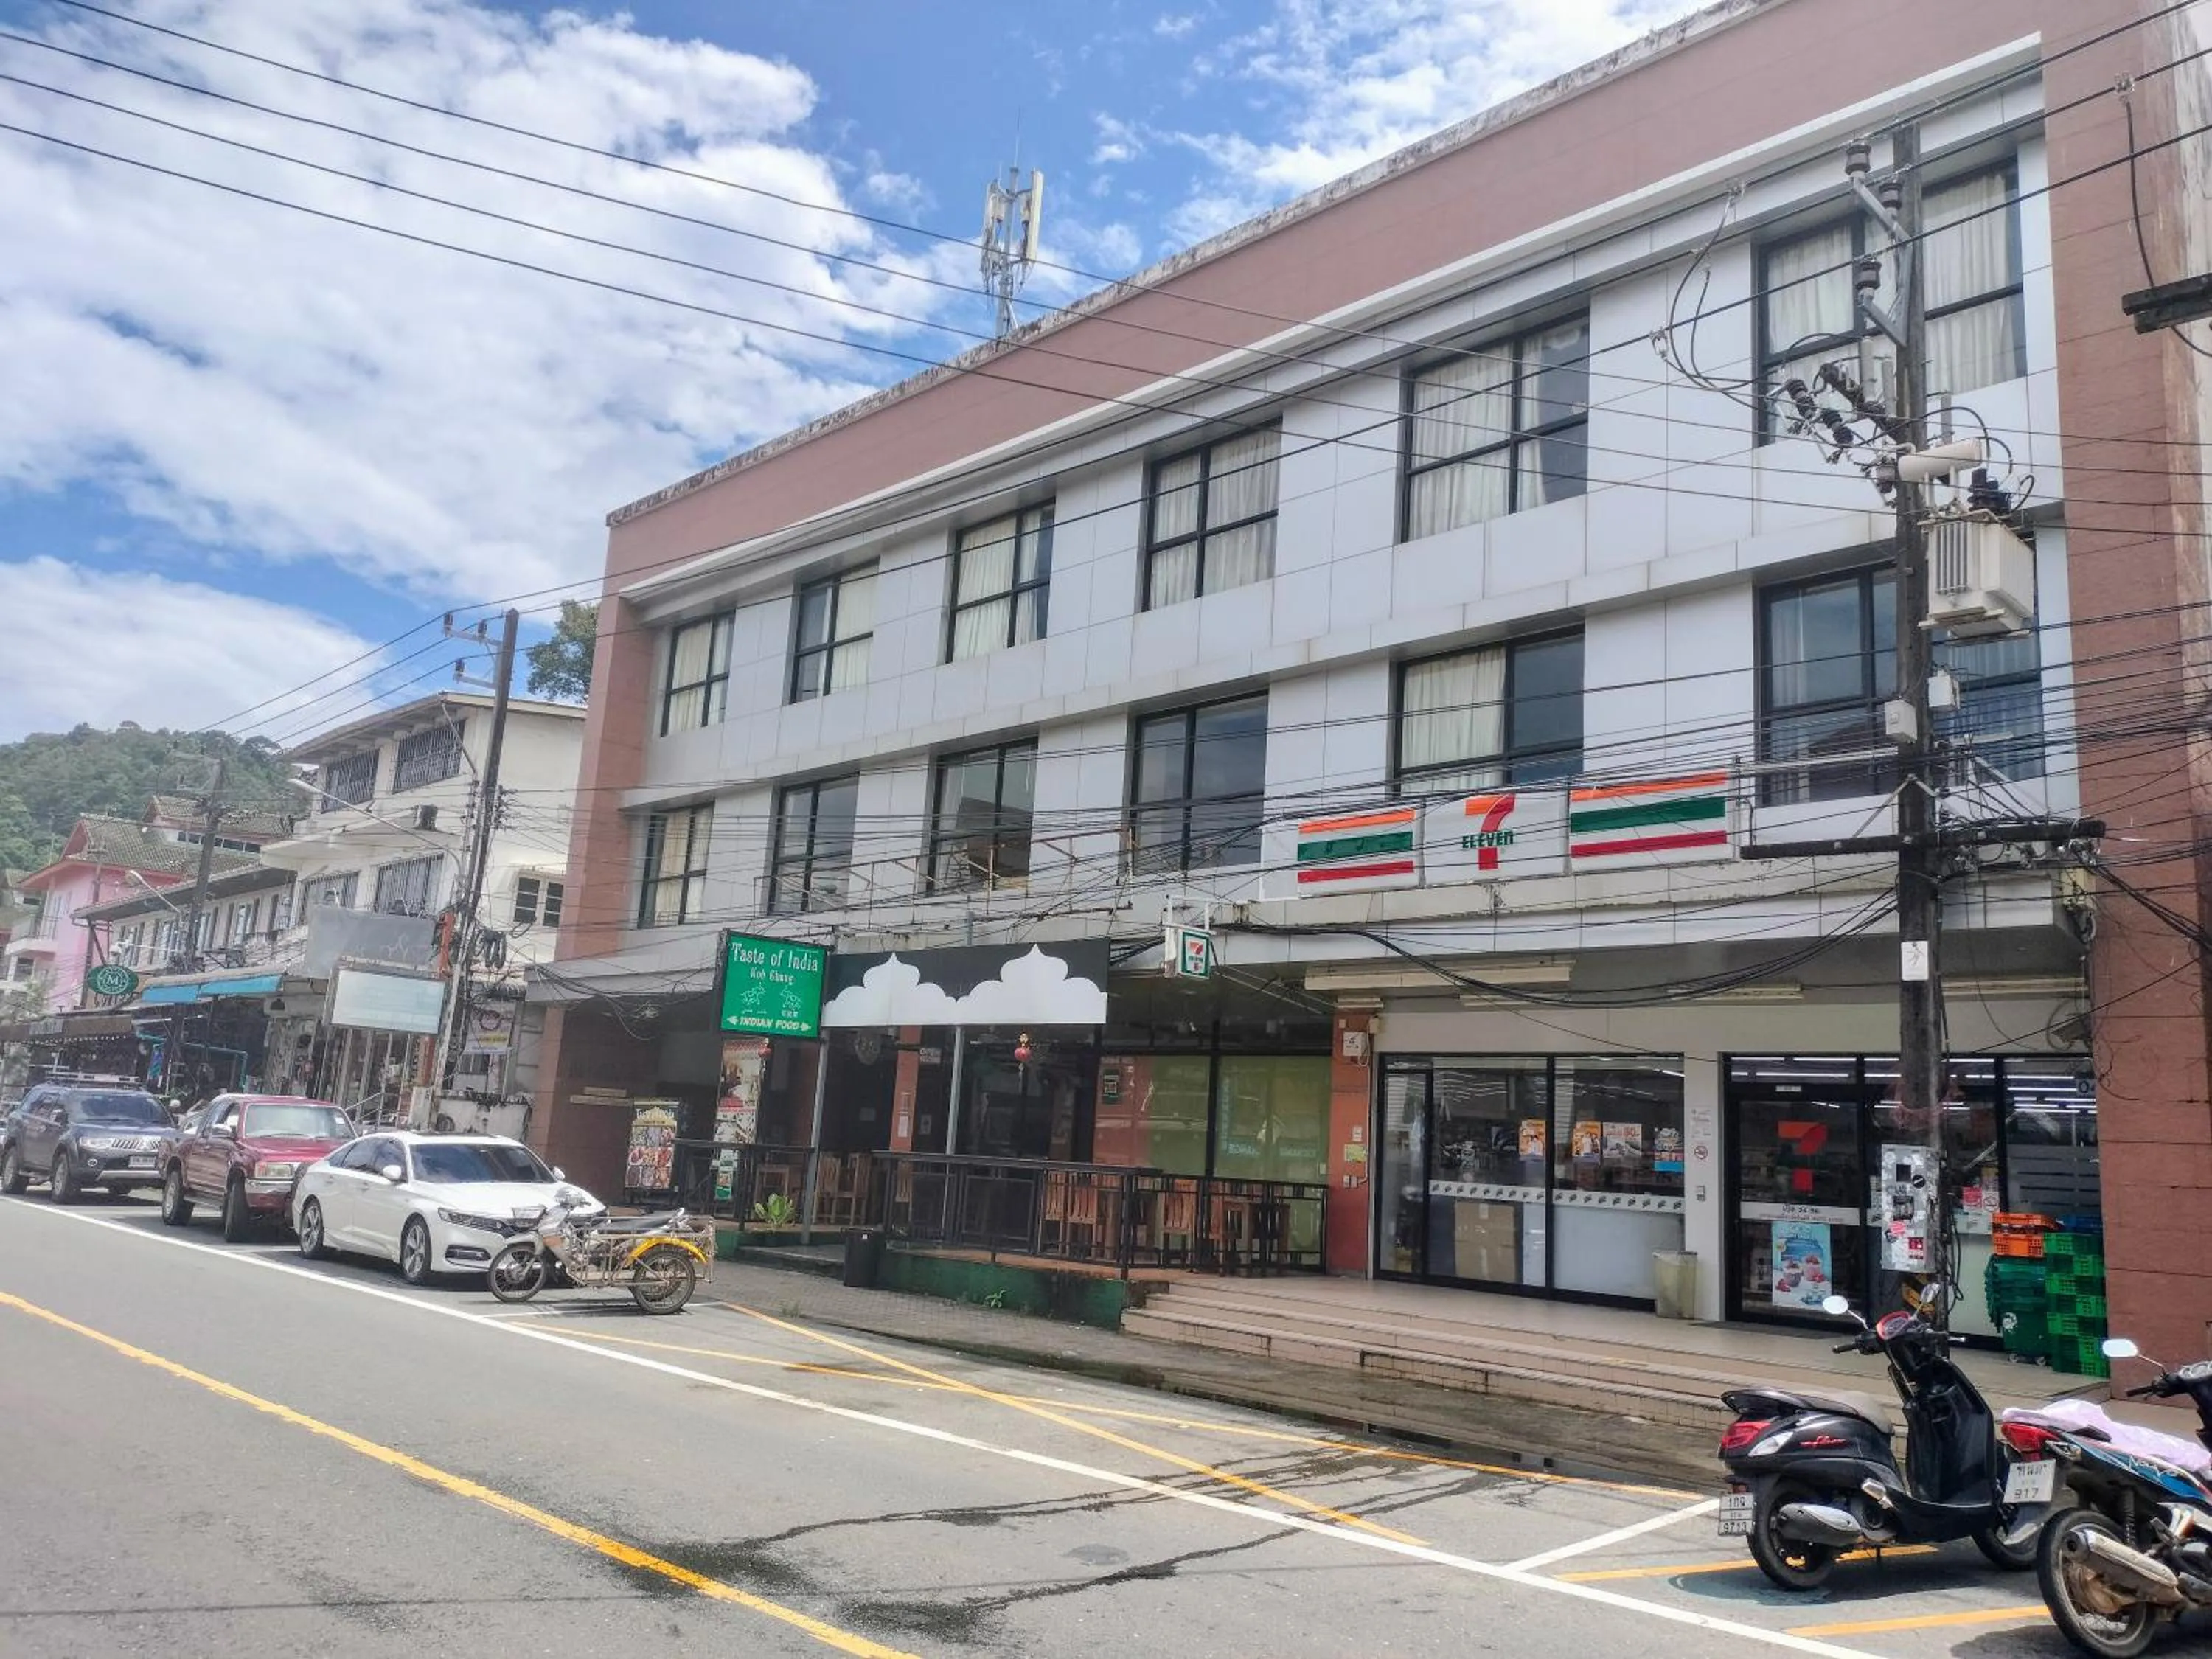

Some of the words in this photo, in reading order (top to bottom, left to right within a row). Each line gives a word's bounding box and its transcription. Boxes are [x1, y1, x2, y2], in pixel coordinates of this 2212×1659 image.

[1464, 793, 1516, 871] 7
[731, 942, 765, 965] Taste
[771, 949, 784, 967] of
[787, 950, 818, 972] India
[740, 1017, 773, 1029] INDIAN
[776, 1020, 800, 1031] FOOD
